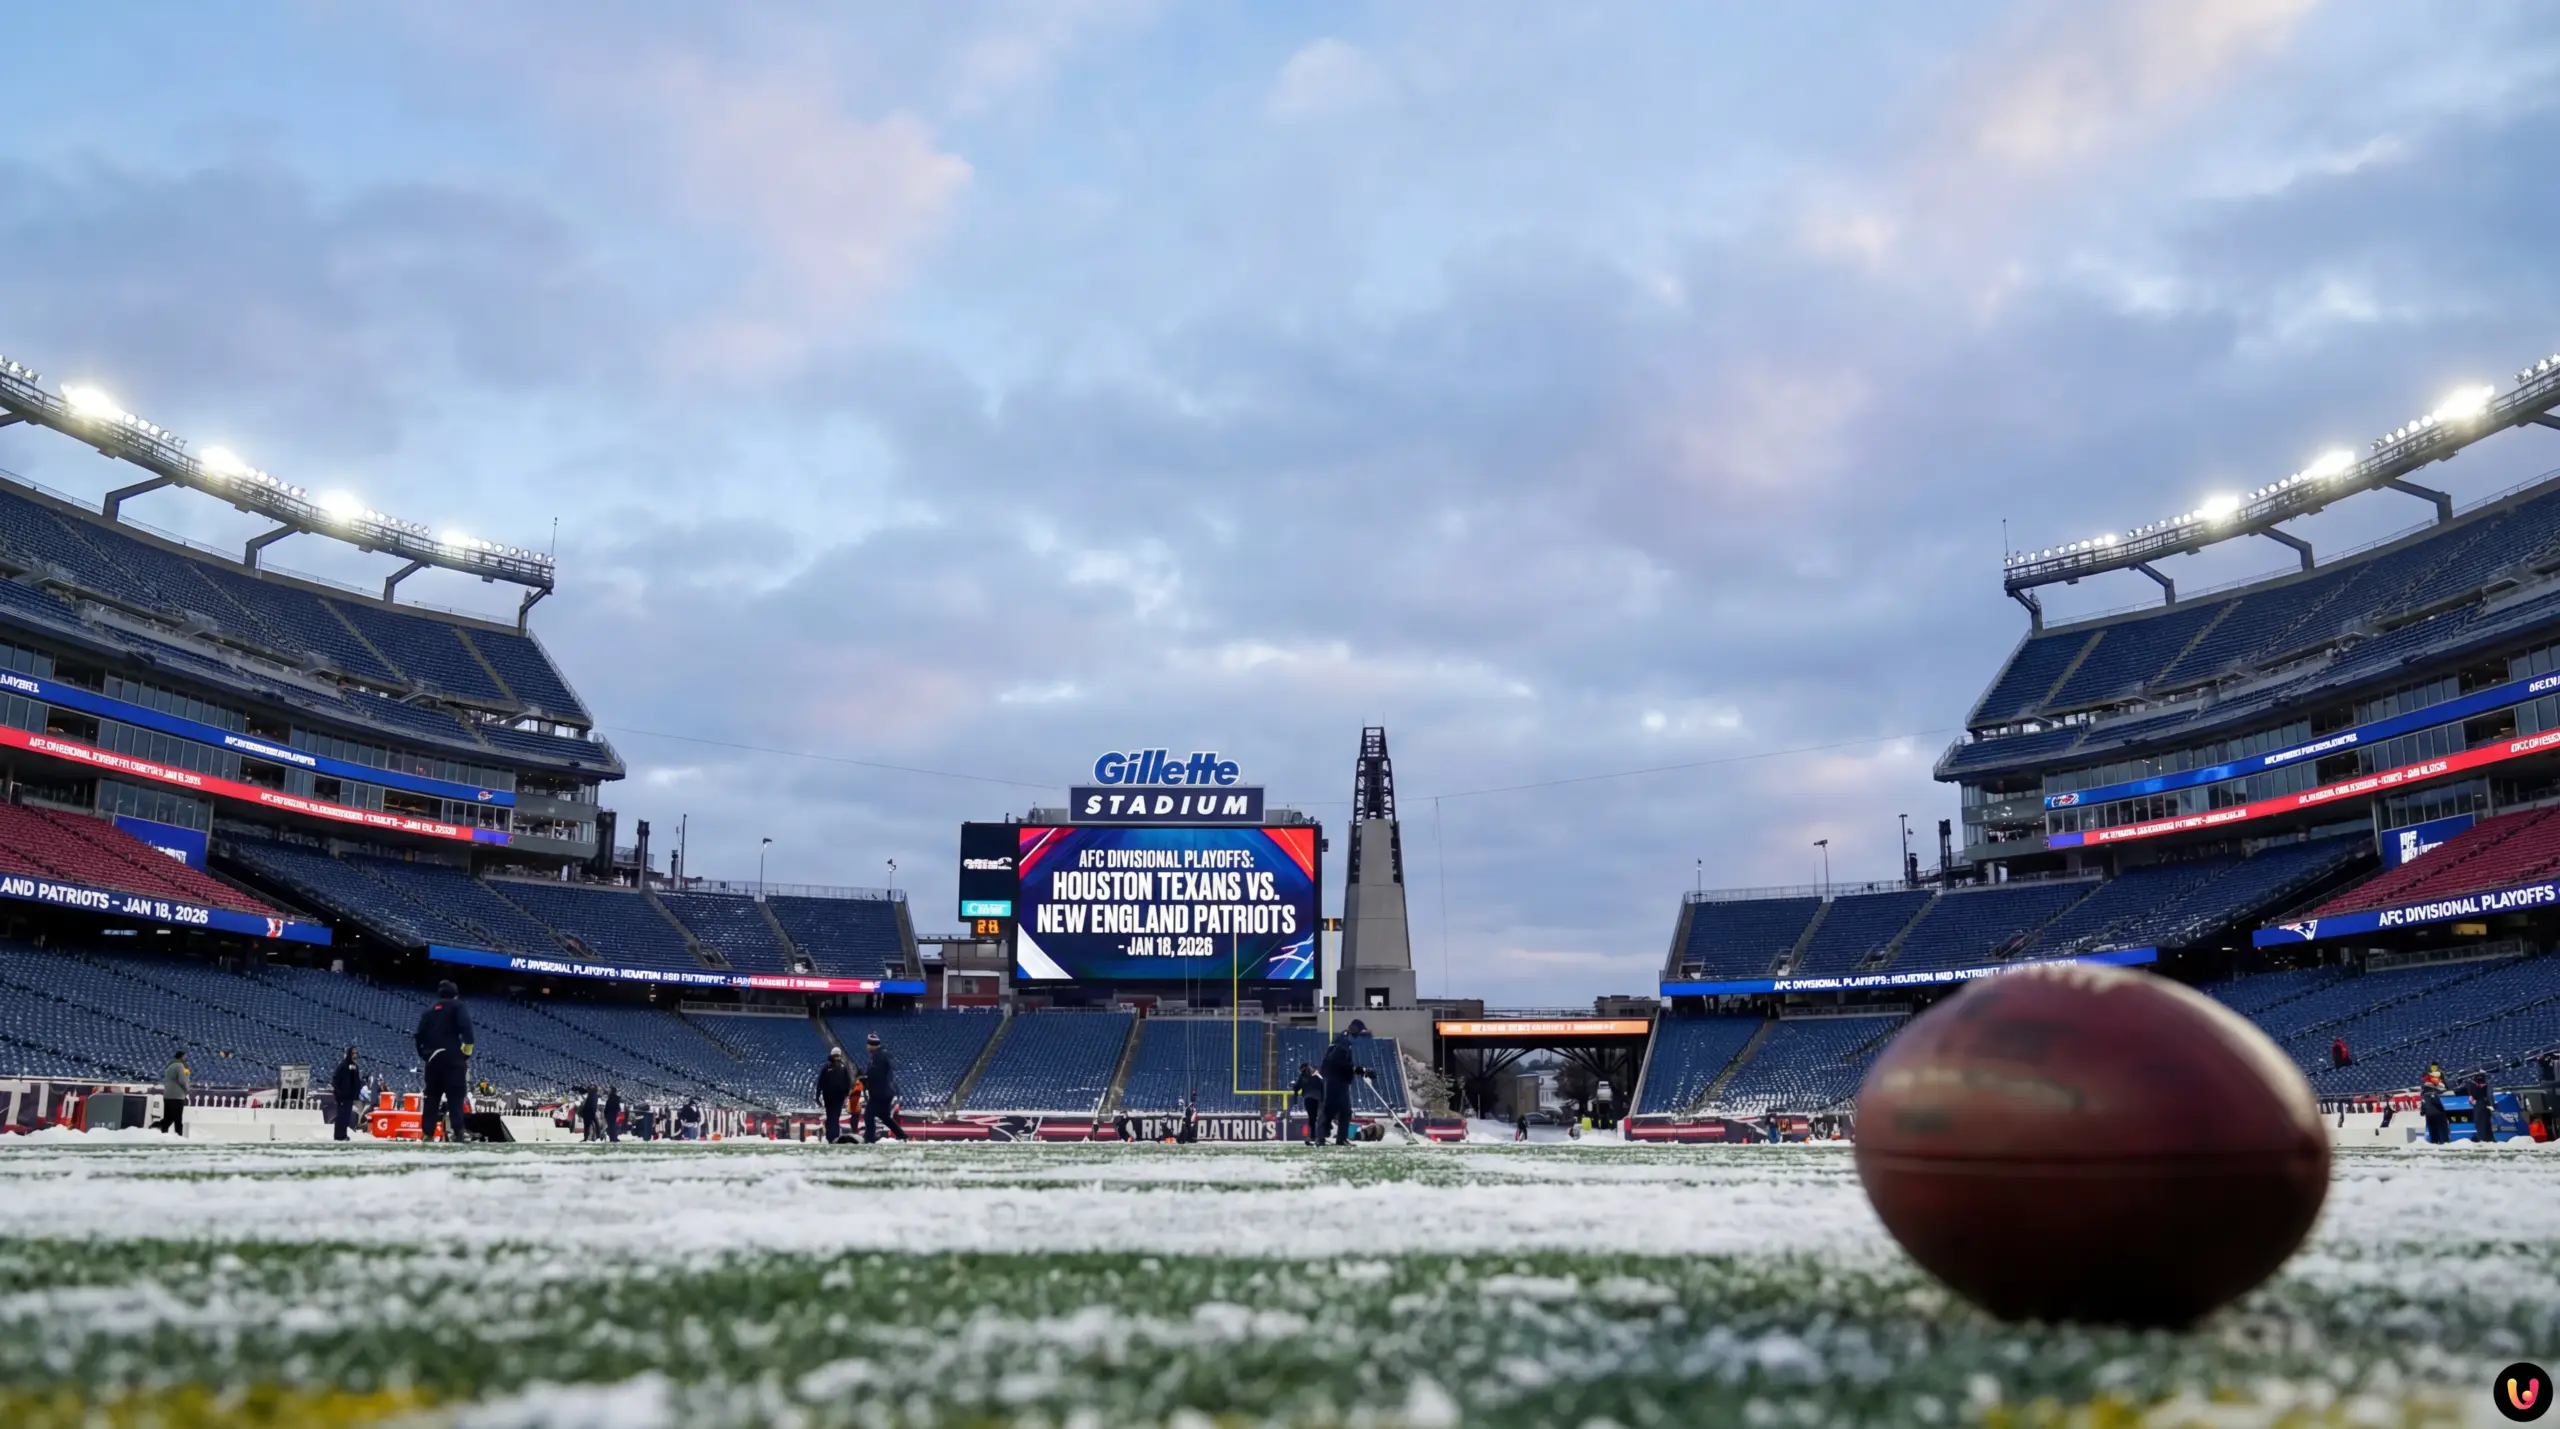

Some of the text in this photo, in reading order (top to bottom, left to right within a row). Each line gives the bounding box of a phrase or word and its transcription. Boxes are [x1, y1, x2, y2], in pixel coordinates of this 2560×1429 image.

[1093, 748, 1241, 786] Gillette
[1085, 795, 1248, 815] STADIUM
[1079, 850, 1254, 868] AFC DIVISIONAL PLAYOFFS:
[0, 877, 35, 897] AND
[38, 883, 109, 909] PATRIOTS
[122, 897, 151, 915] JAN
[154, 902, 172, 921] 18,
[175, 905, 209, 924] 2026
[1053, 871, 1280, 901] HOUSTON TEXANS VS.
[1037, 904, 1087, 933] NEW
[1092, 904, 1189, 934] ENGLAND
[1194, 904, 1296, 934] PATRIOTS
[2379, 885, 2555, 927] AFC DIVISIONAL PLAYOFFS
[1127, 937, 1154, 956] JAN
[1156, 937, 1175, 958] 18,
[1177, 937, 1213, 956] 2026
